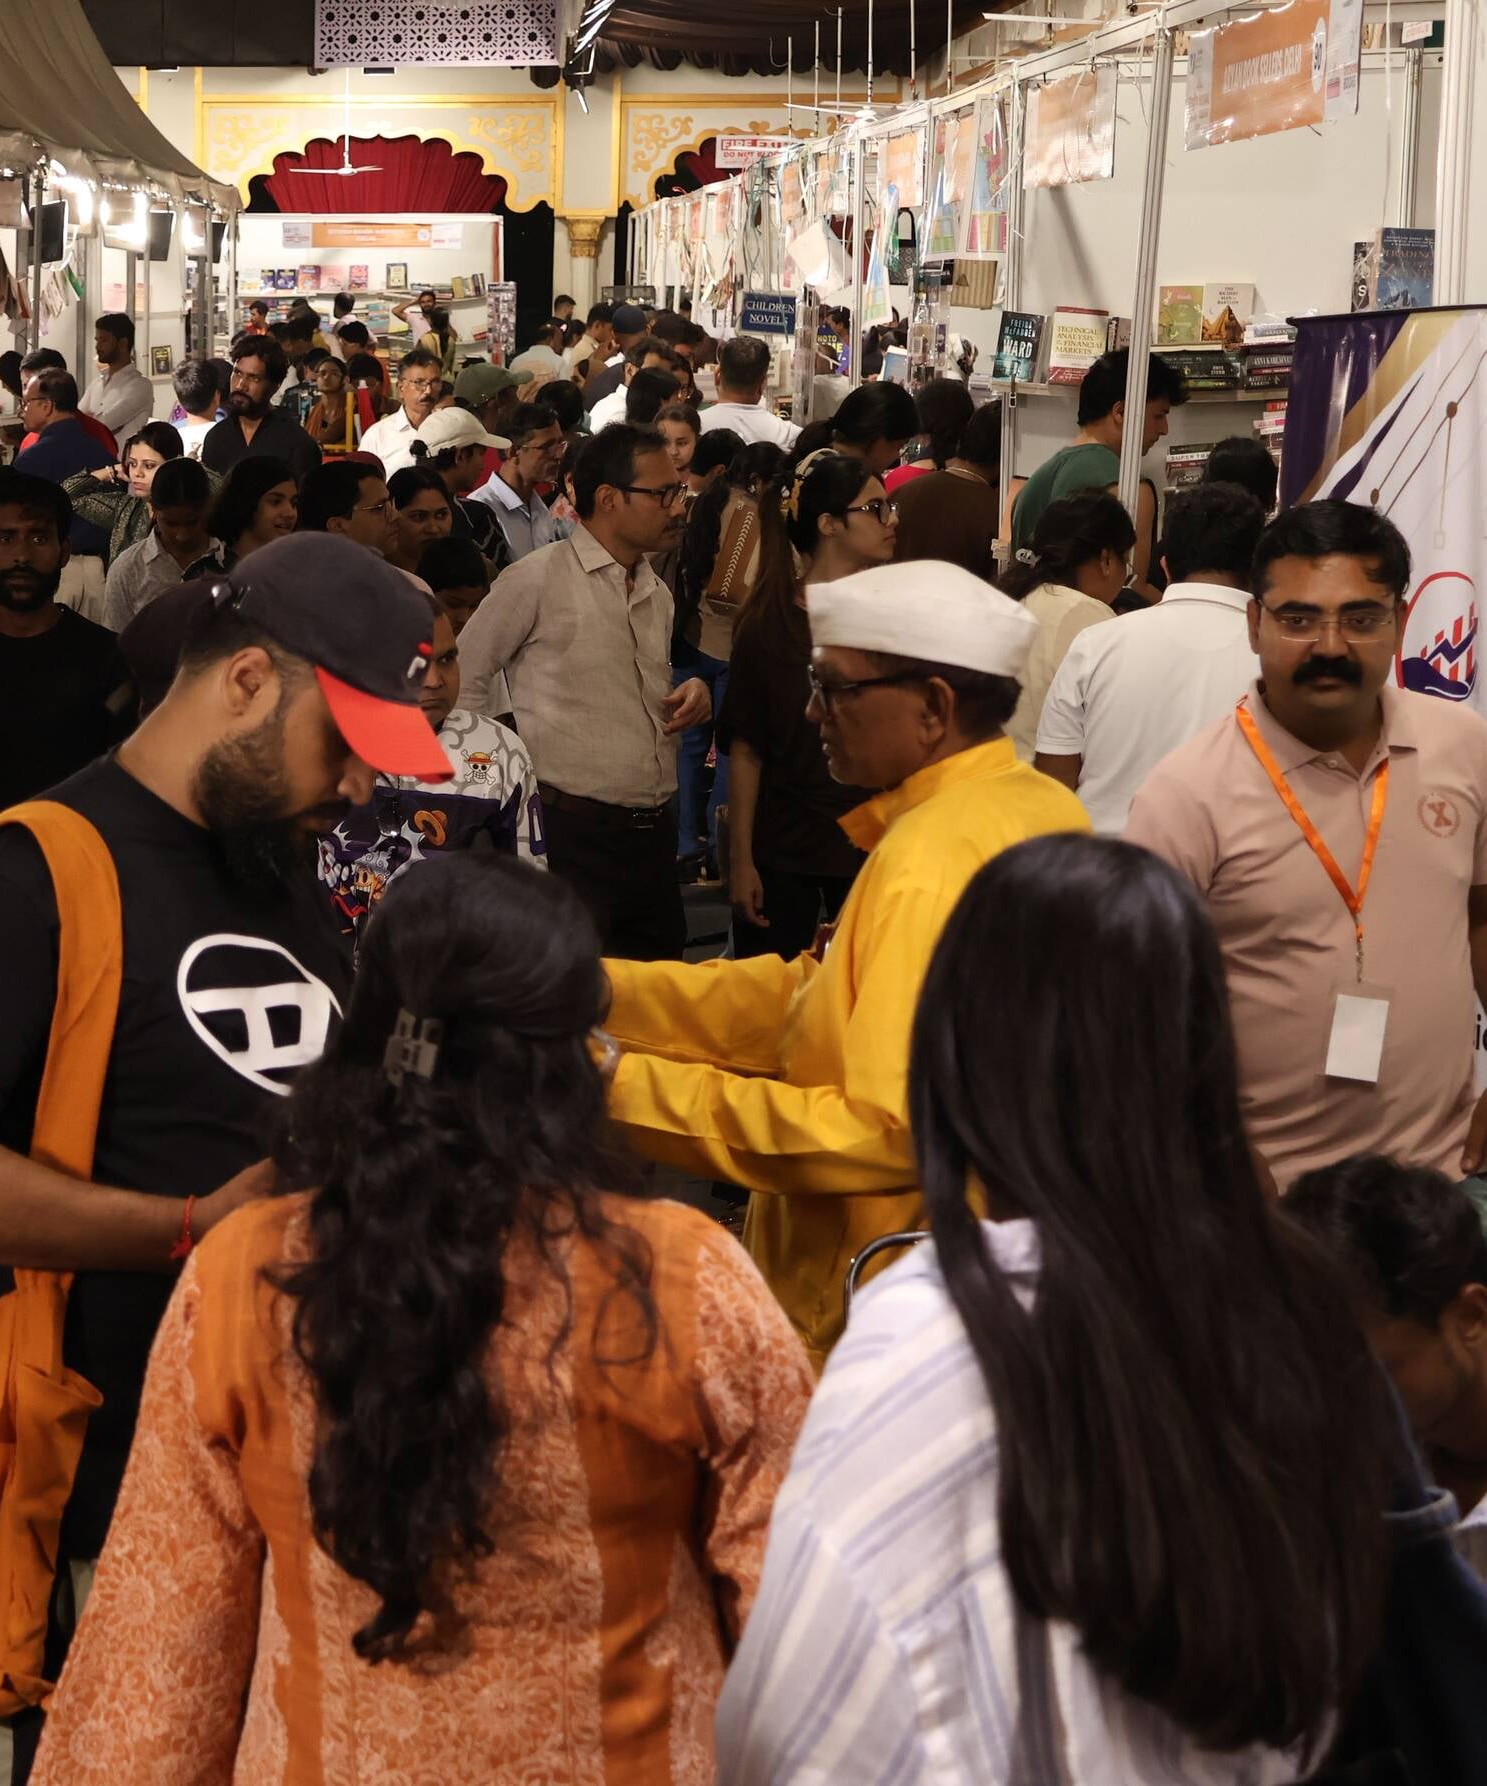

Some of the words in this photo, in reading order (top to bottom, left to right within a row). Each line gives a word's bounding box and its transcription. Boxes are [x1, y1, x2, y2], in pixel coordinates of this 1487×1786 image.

[1384, 250, 1433, 259] TRADIN
[746, 300, 794, 313] CHILDREN
[749, 313, 789, 324] NOVELS
[1057, 326, 1098, 335] TECHNICAL
[1057, 333, 1094, 342] ANALYSIS
[1003, 339, 1033, 358] WARD
[1063, 341, 1104, 350] FINANCIAL
[1056, 346, 1093, 355] MARKETS
